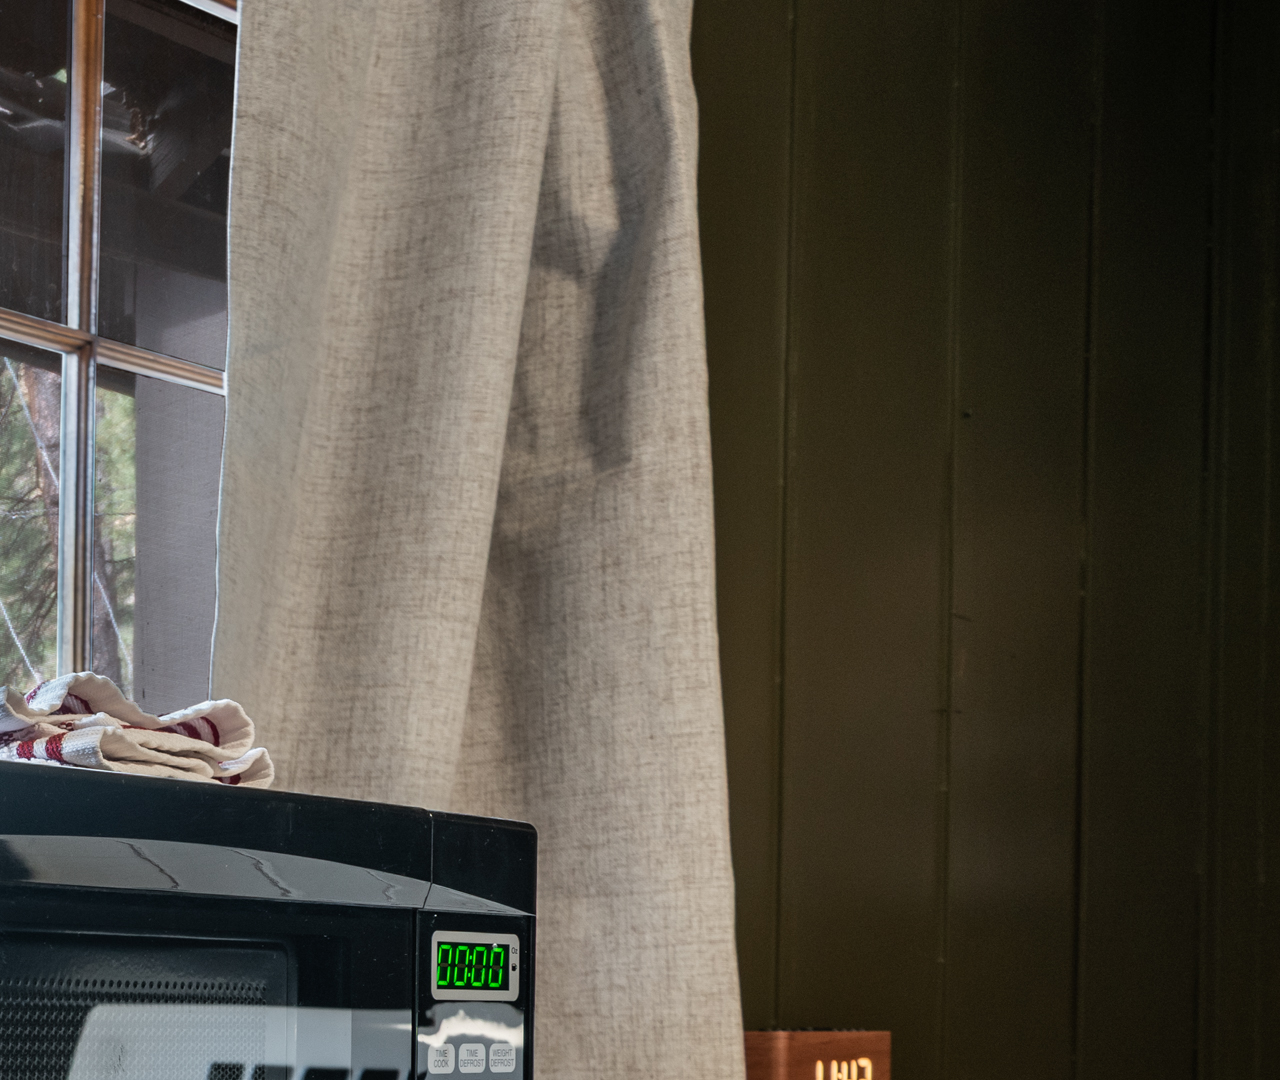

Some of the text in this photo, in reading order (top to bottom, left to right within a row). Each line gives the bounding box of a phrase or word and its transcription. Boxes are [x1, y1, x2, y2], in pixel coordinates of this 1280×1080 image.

[437, 945, 504, 988] 00:00
[435, 1049, 448, 1058] TIME
[466, 1049, 478, 1058] TIME
[492, 1048, 513, 1057] WEIGHT
[433, 1059, 449, 1068] COOK
[460, 1058, 484, 1068] DEFROST
[490, 1058, 514, 1067] DEFROST
